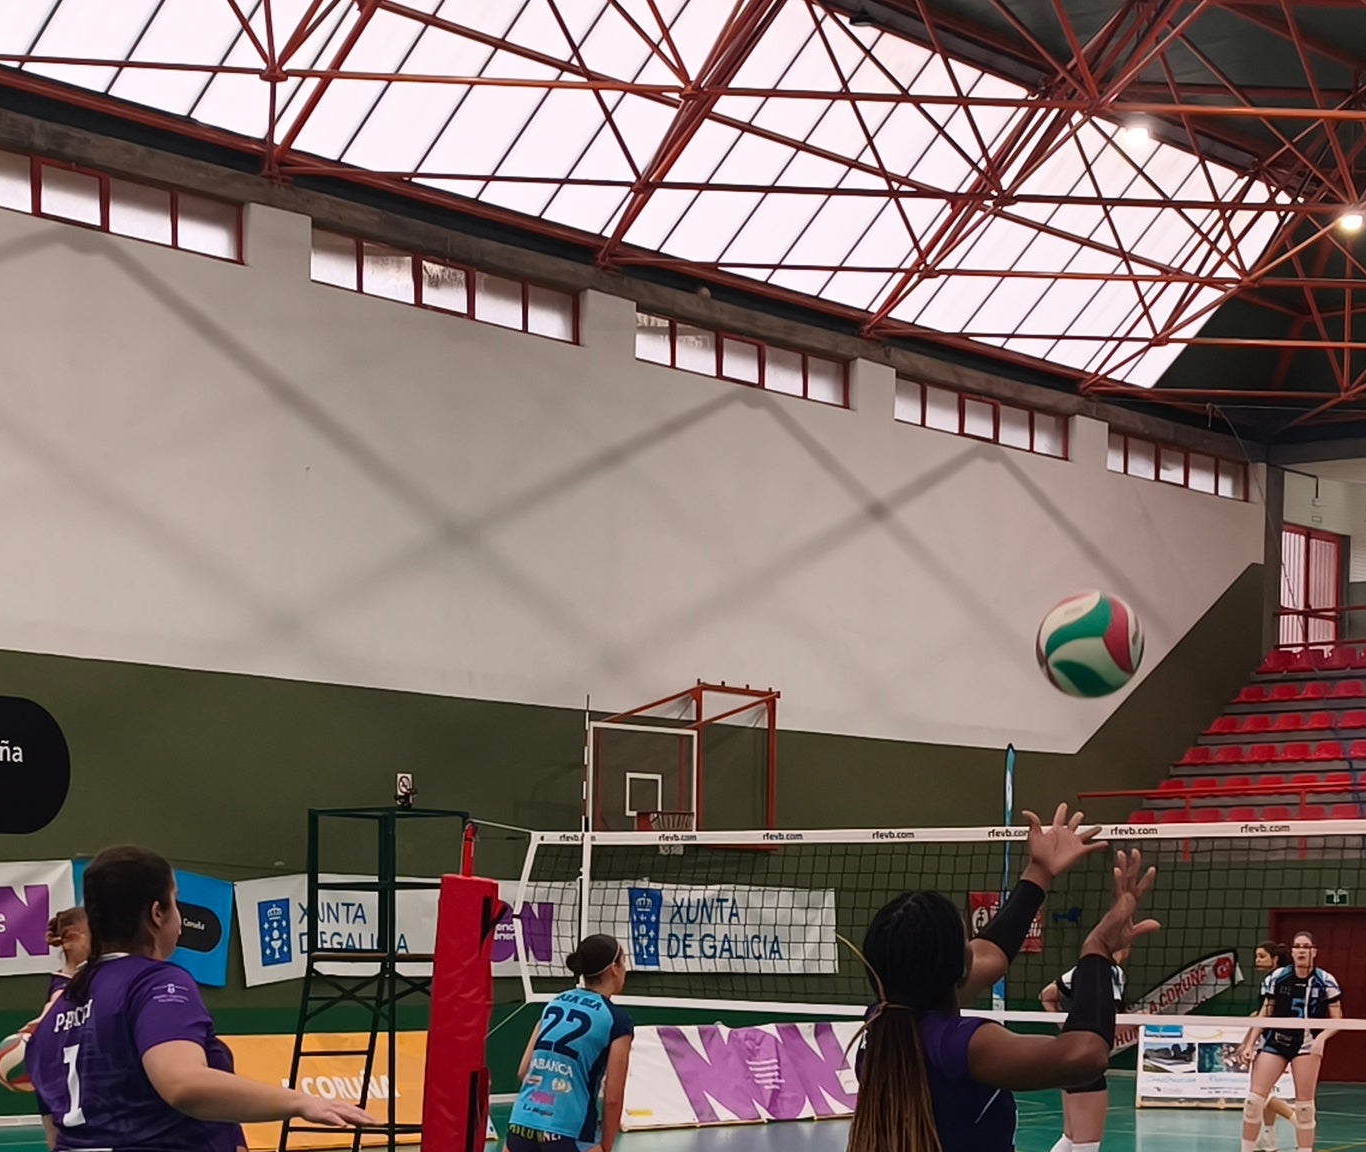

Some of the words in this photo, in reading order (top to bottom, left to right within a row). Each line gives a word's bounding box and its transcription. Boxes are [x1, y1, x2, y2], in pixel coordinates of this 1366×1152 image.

[658, 832, 697, 843] rfevb.com
[762, 831, 803, 841] rfevb.com
[872, 831, 915, 840] rfevb.com
[1110, 826, 1158, 836] rfevb.com
[1240, 823, 1290, 834] rfevb.com
[671, 898, 740, 924] XUNTA
[330, 932, 410, 954] GALIA
[667, 933, 694, 959] DE
[700, 933, 783, 960] GALICIA
[534, 1006, 592, 1060] 22
[531, 1059, 574, 1078] ABANCA
[62, 1044, 87, 1128] 1
